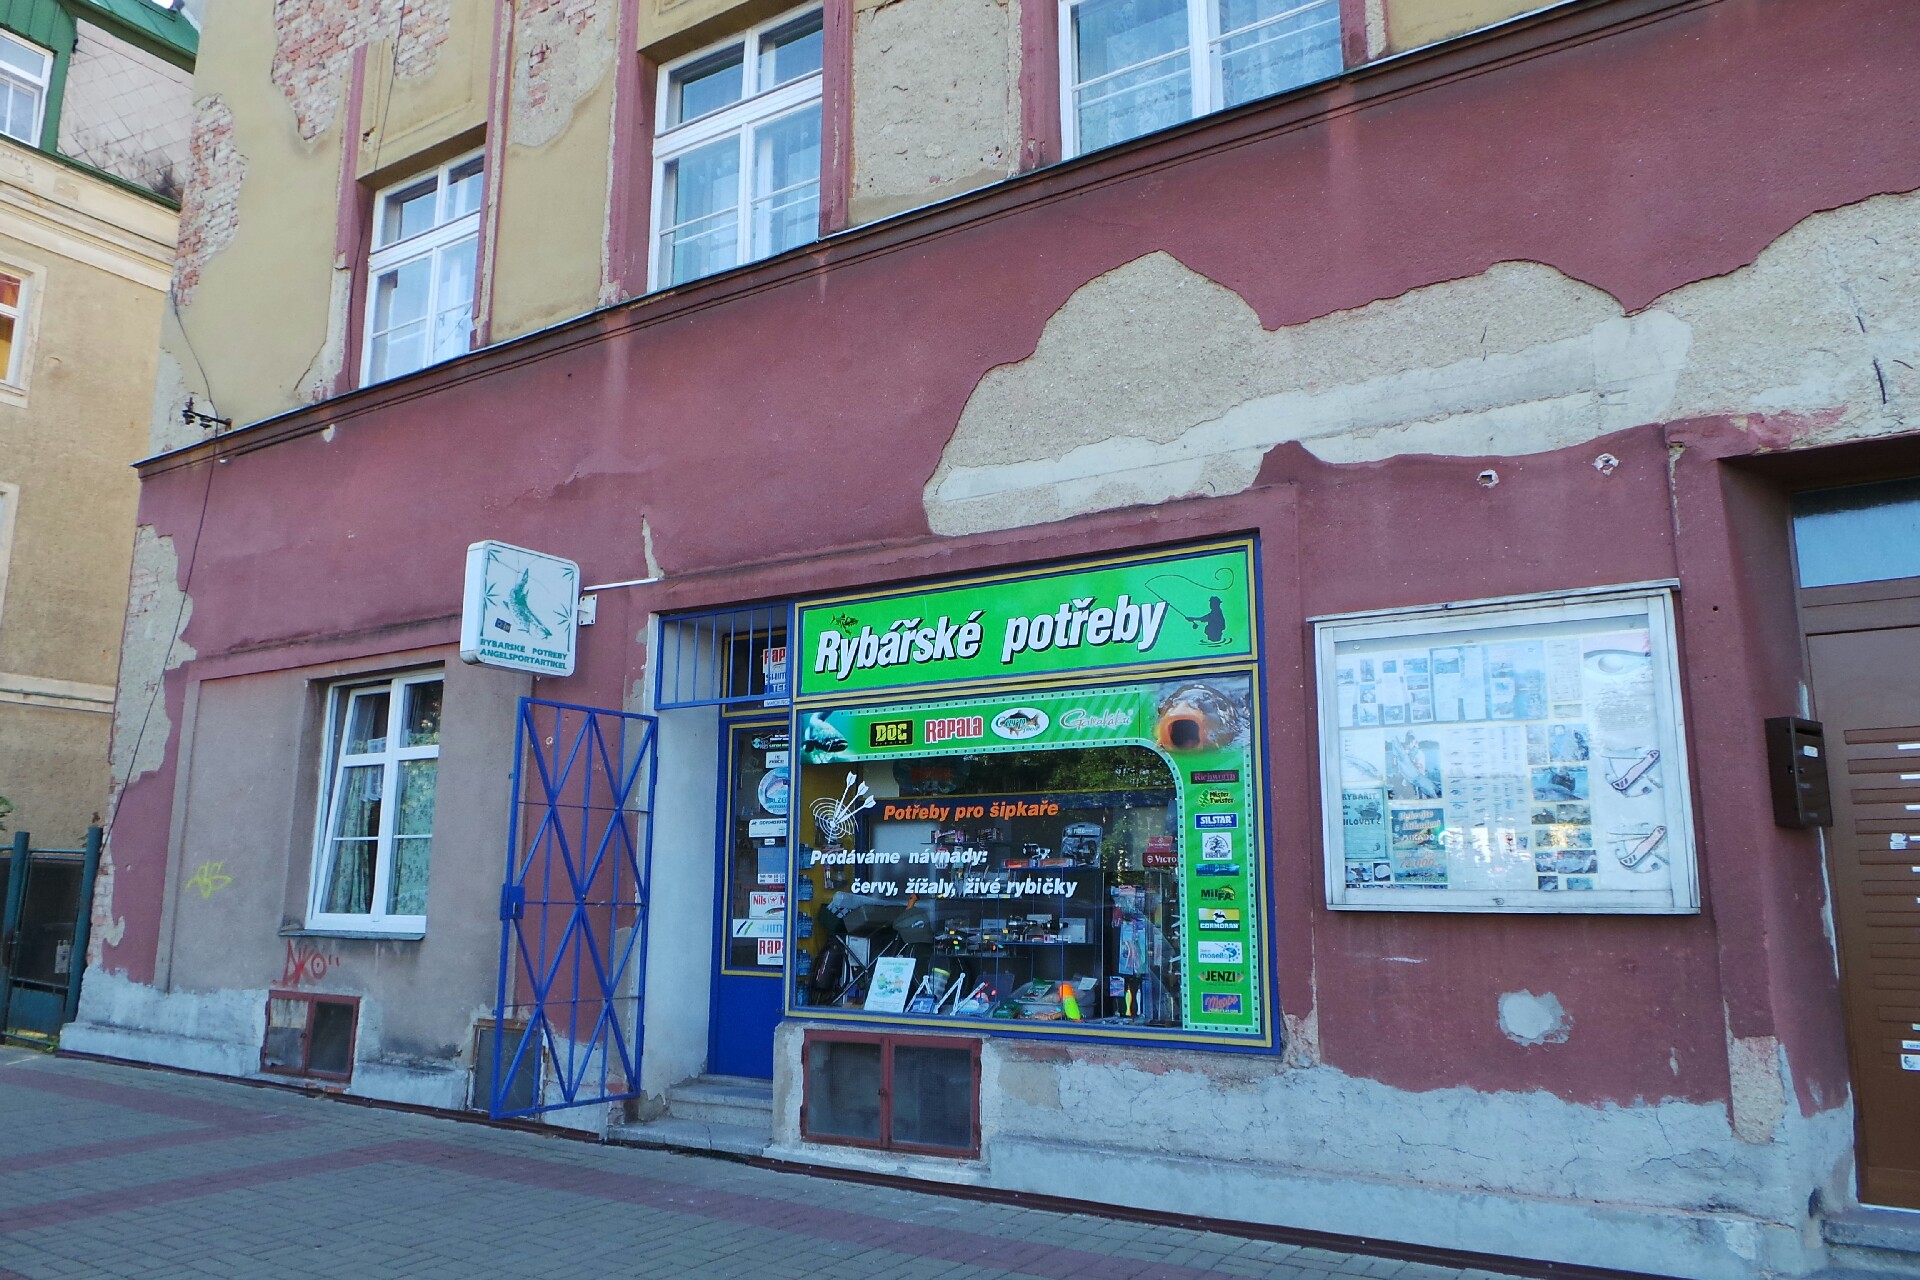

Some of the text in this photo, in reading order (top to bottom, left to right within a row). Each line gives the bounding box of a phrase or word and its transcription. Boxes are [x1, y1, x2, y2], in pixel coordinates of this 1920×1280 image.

[814, 594, 1168, 681] Rybářské potřeby
[480, 639, 568, 660] RYBARSKE POTREBY
[480, 648, 568, 669] ANGELSPORTARTIKEL
[875, 723, 908, 742] DOC
[884, 799, 1059, 822] Potřeby pro šipkaře
[1200, 815, 1233, 825] SILSTAR
[810, 848, 988, 867] Prodáváme návnady:
[851, 876, 1078, 898] červy, žížaly, živé rybičky
[754, 895, 767, 905] Nils
[1205, 970, 1236, 982] JENZI
